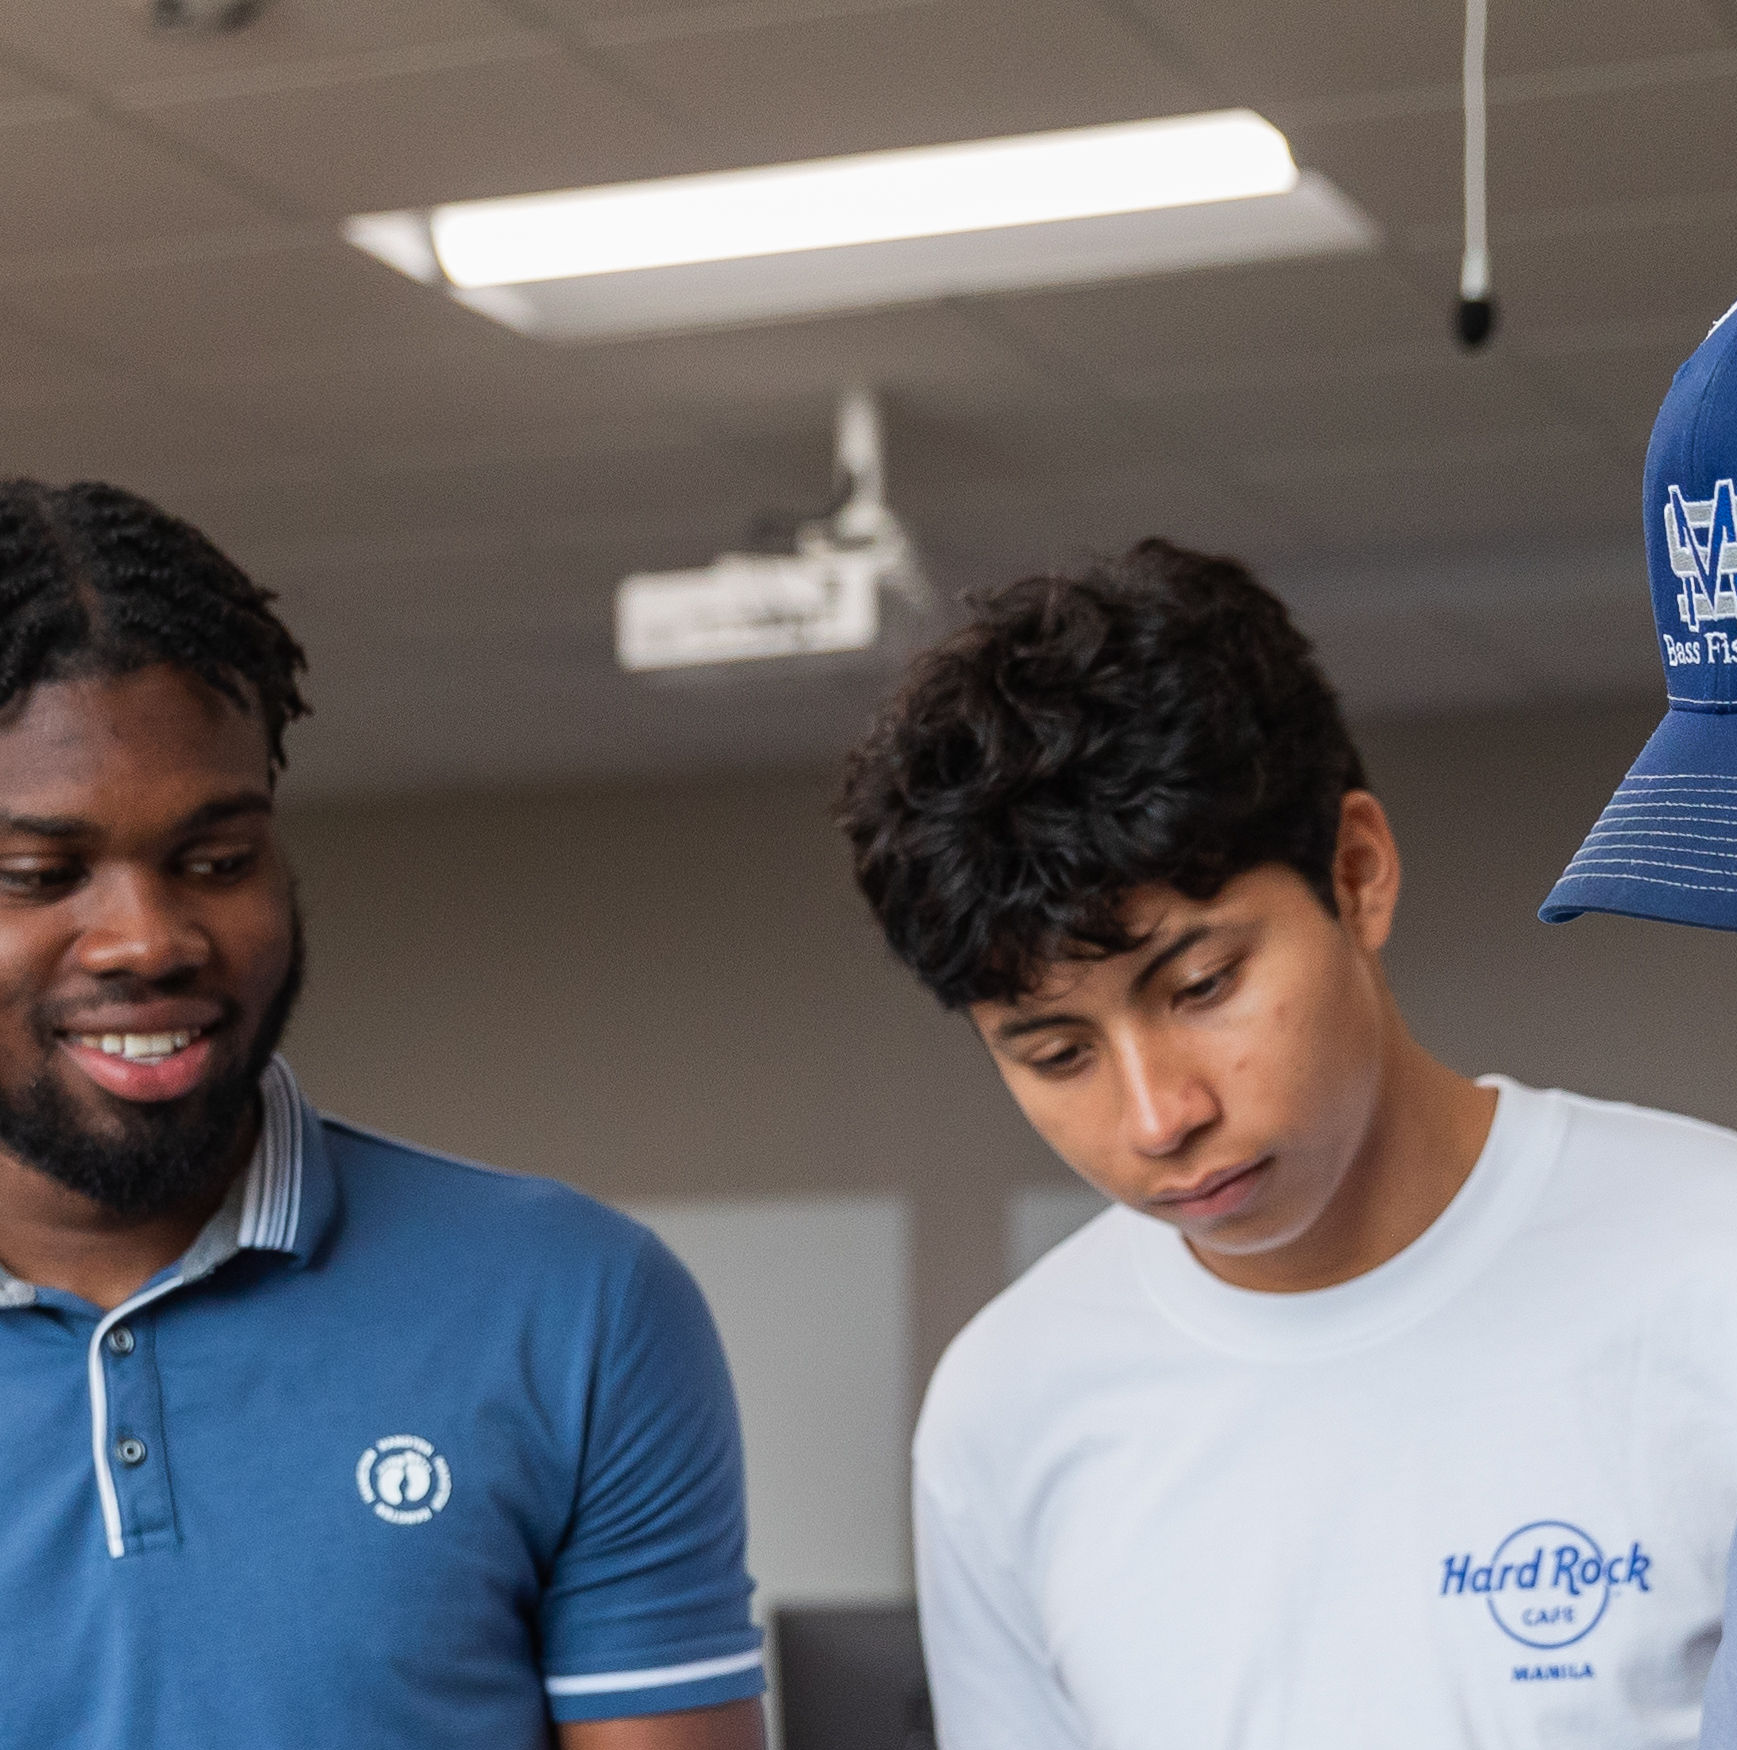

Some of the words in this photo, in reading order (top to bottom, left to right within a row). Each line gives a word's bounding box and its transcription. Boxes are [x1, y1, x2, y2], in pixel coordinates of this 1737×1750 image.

[1663, 634, 1701, 667] Bass
[1439, 1547, 1545, 1596] Hard
[1551, 1542, 1652, 1597] Rock
[1521, 1604, 1576, 1627] CAFE
[1511, 1662, 1594, 1682] MANILA
